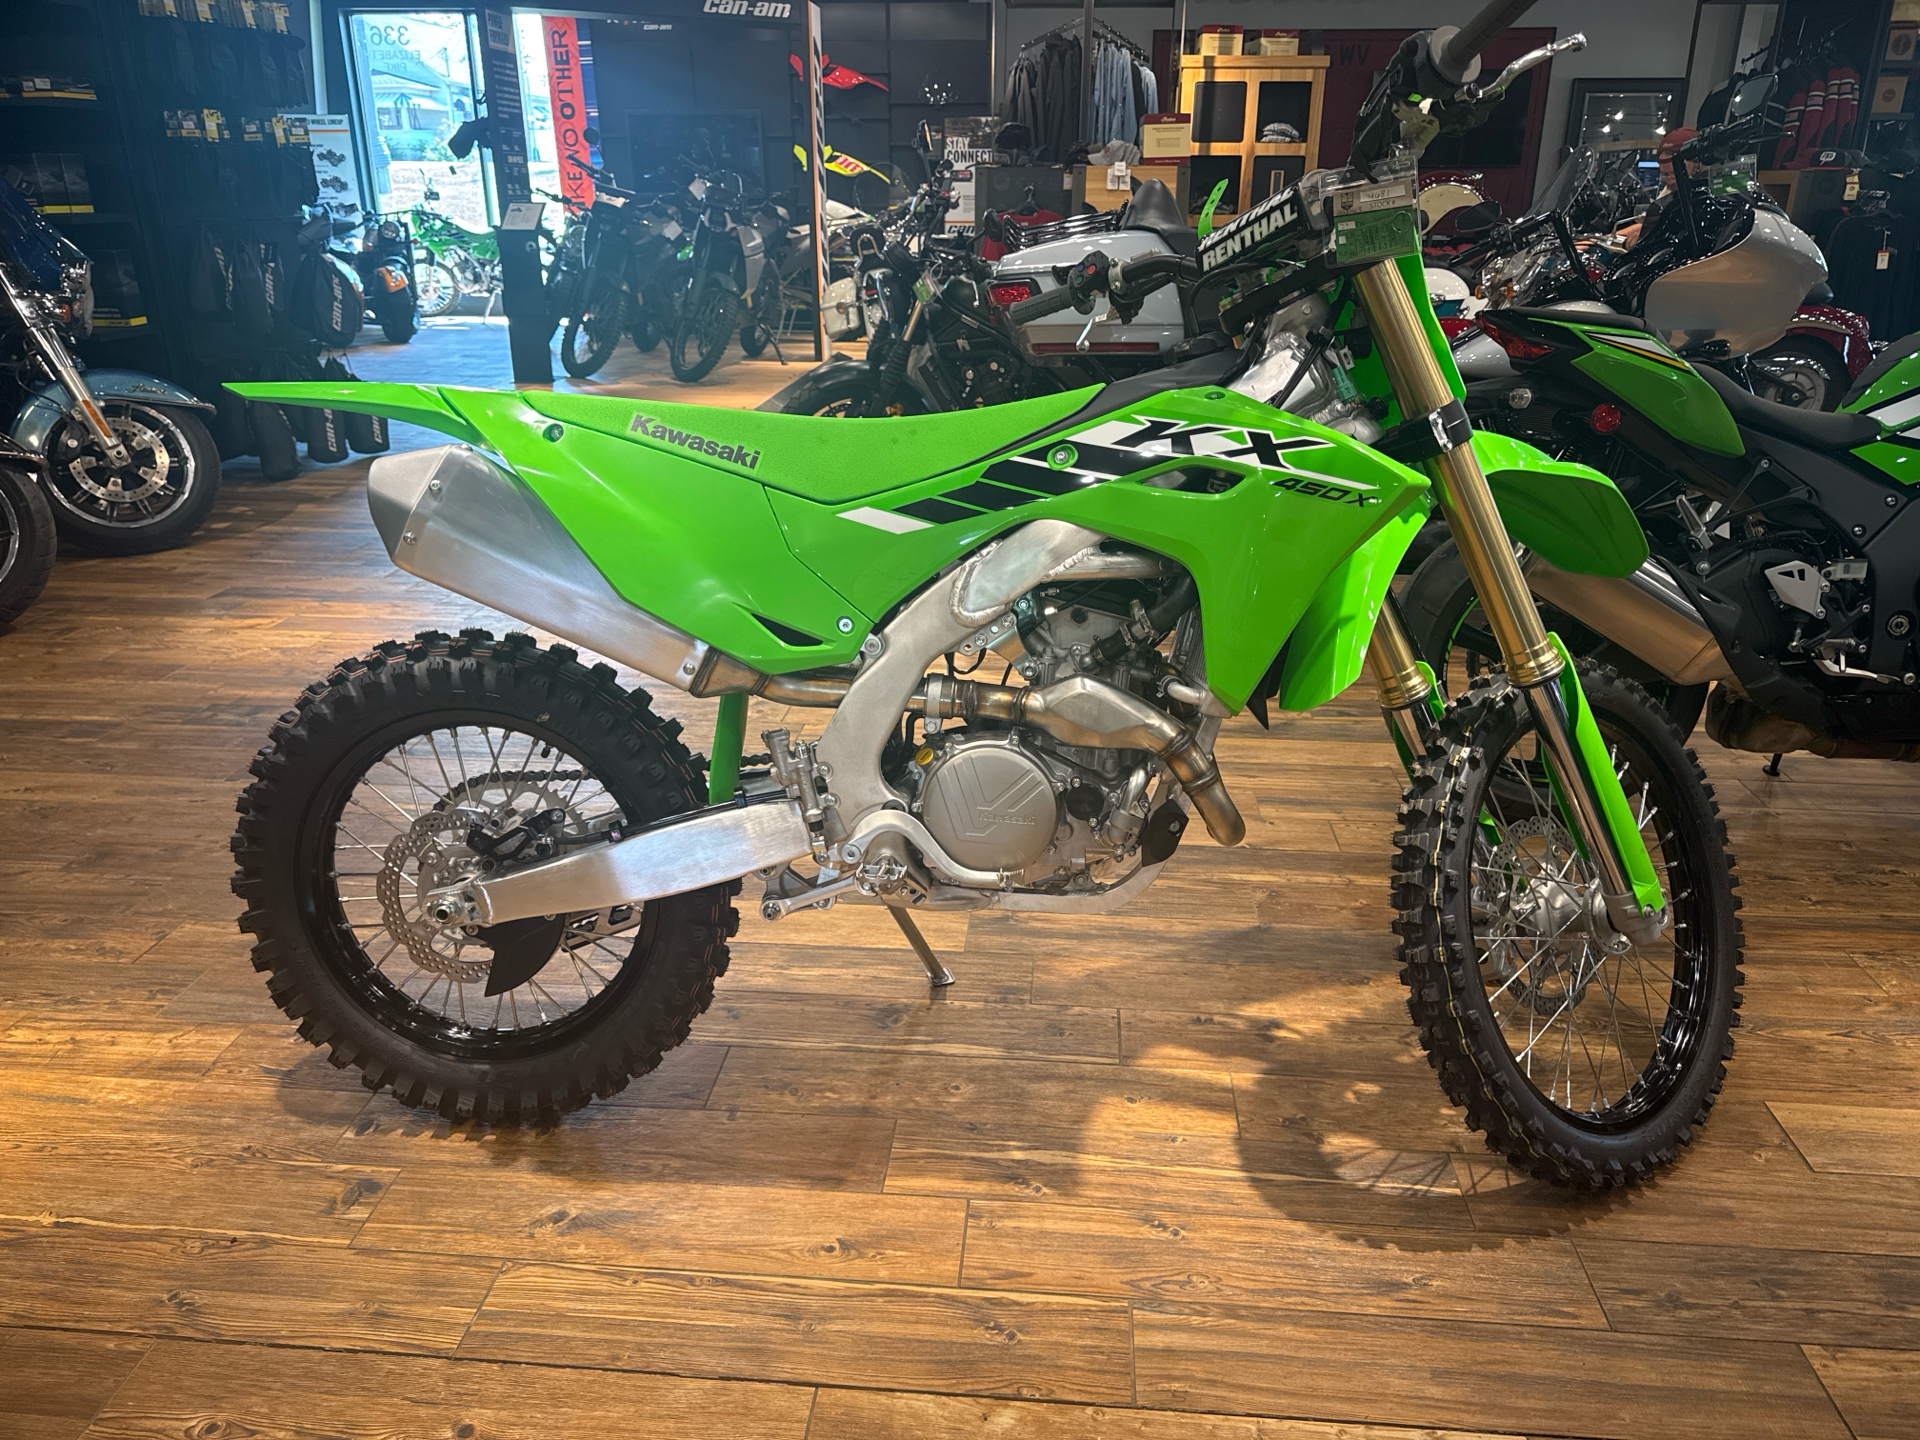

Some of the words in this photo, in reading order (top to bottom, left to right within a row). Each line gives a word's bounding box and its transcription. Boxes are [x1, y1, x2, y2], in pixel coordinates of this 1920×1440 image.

[551, 30, 575, 120] OTHER
[946, 137, 970, 149] STAY
[947, 150, 993, 163] CONNECT
[1369, 201, 1391, 209] STOCK
[1202, 202, 1298, 272] RENTHAL
[630, 414, 761, 470] Kawasaki
[1109, 418, 1335, 471] KX
[978, 810, 1036, 826] Kawasaki
